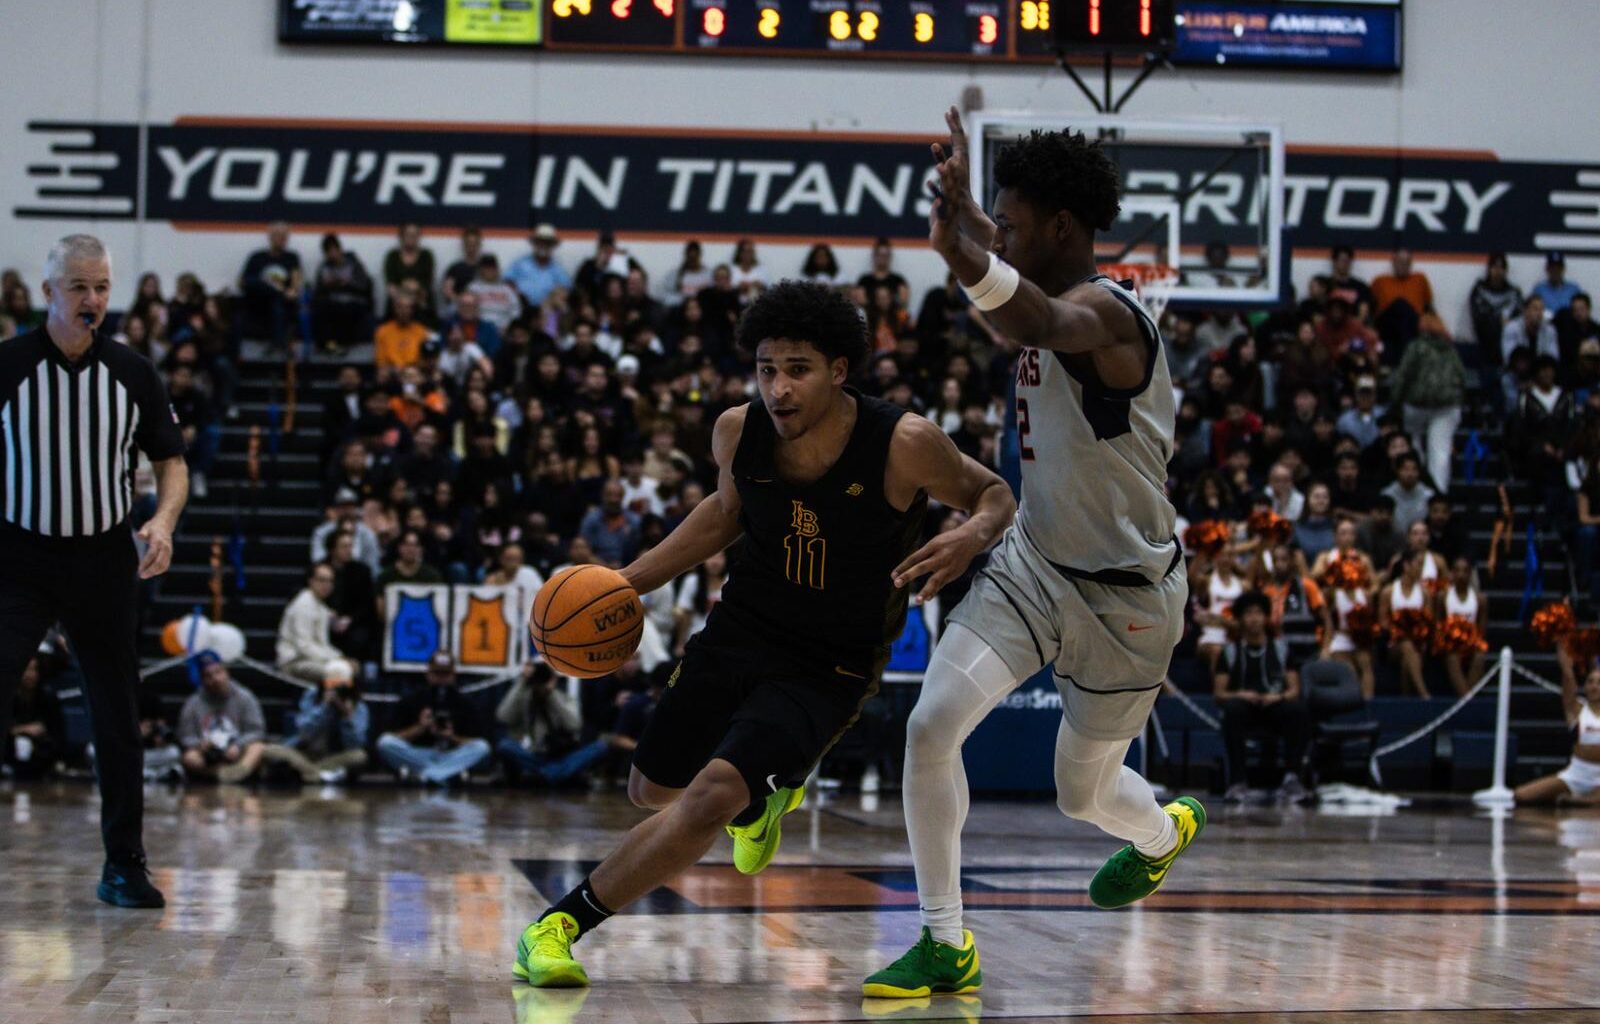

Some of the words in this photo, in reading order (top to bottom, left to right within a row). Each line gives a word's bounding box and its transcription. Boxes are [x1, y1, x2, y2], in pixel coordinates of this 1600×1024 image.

[157, 147, 506, 206] YOU'RE
[531, 155, 628, 209] IN
[783, 534, 826, 590] 11
